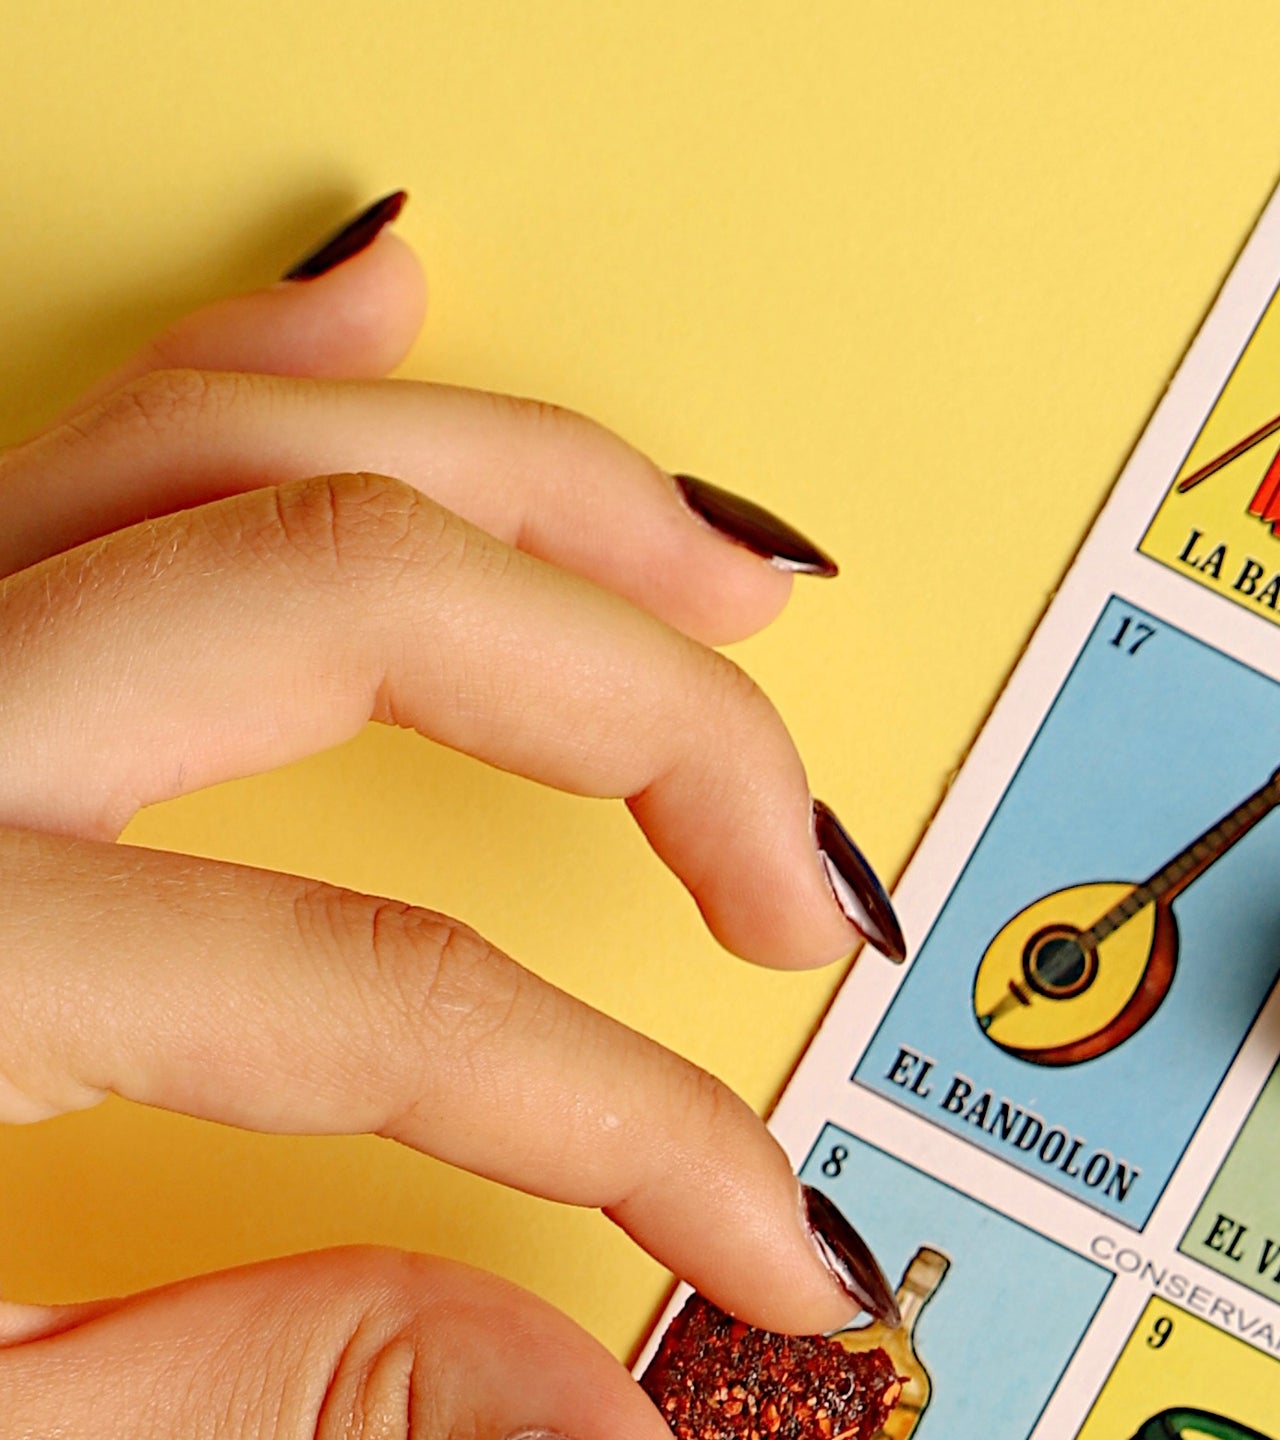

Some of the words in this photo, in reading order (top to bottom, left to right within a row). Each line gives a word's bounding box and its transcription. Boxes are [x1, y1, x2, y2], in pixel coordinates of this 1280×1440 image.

[1178, 530, 1220, 582] LA
[1108, 615, 1156, 657] 17
[885, 1049, 934, 1092] EL
[940, 1077, 1142, 1203] BANDOLON
[821, 1145, 848, 1179] 8
[1203, 1214, 1250, 1262] EL
[1146, 1317, 1173, 1350] 9
